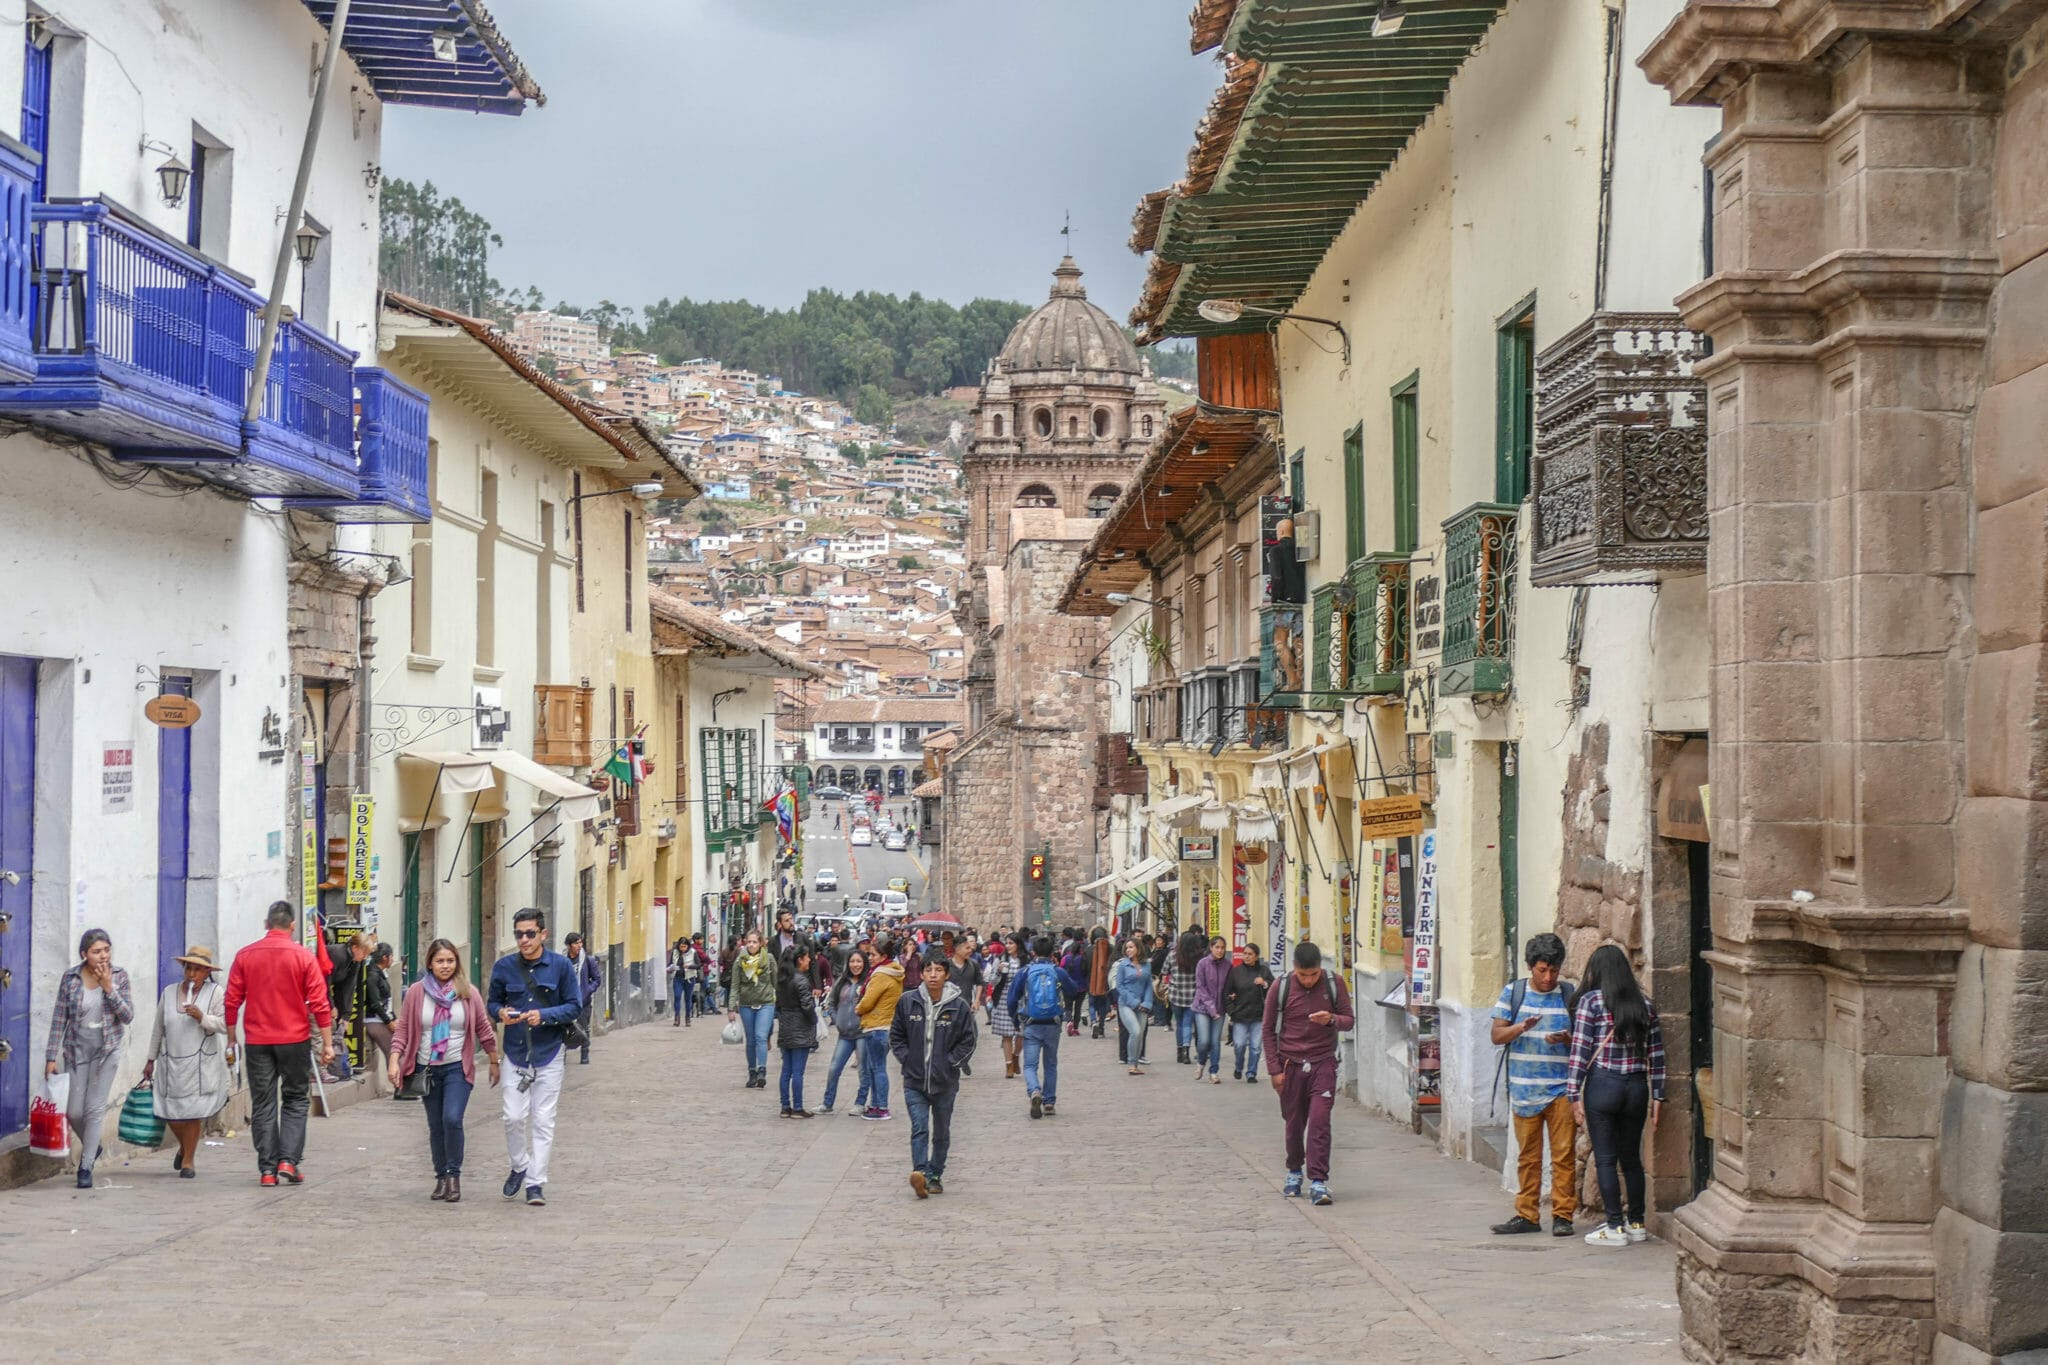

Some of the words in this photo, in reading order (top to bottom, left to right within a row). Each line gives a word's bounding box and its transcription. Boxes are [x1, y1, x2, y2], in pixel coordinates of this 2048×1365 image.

[163, 711, 184, 719] VISA
[1384, 813, 1402, 821] SALT
[1403, 811, 1421, 819] FLAT
[355, 804, 369, 880] DOLARES
